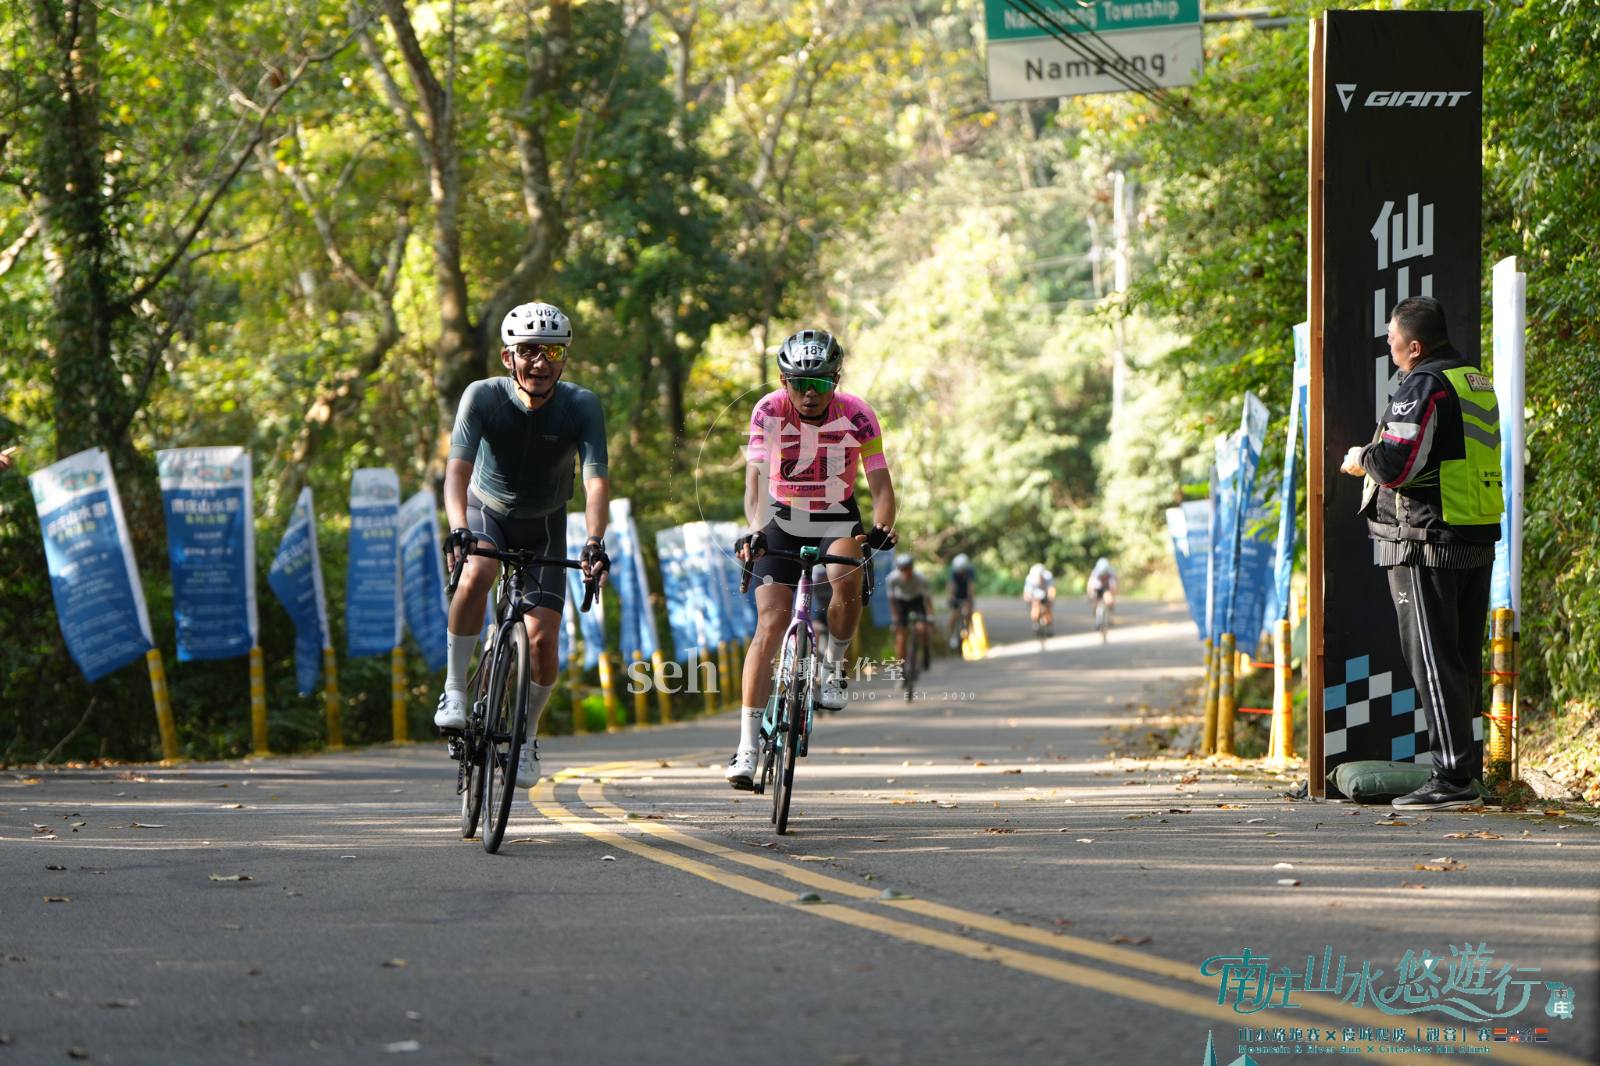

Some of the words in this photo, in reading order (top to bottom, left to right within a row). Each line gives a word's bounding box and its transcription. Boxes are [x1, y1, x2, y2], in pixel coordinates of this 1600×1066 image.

[1103, 1, 1180, 22] Township
[1025, 53, 1165, 82] Namzong
[1364, 90, 1472, 107] GIANT
